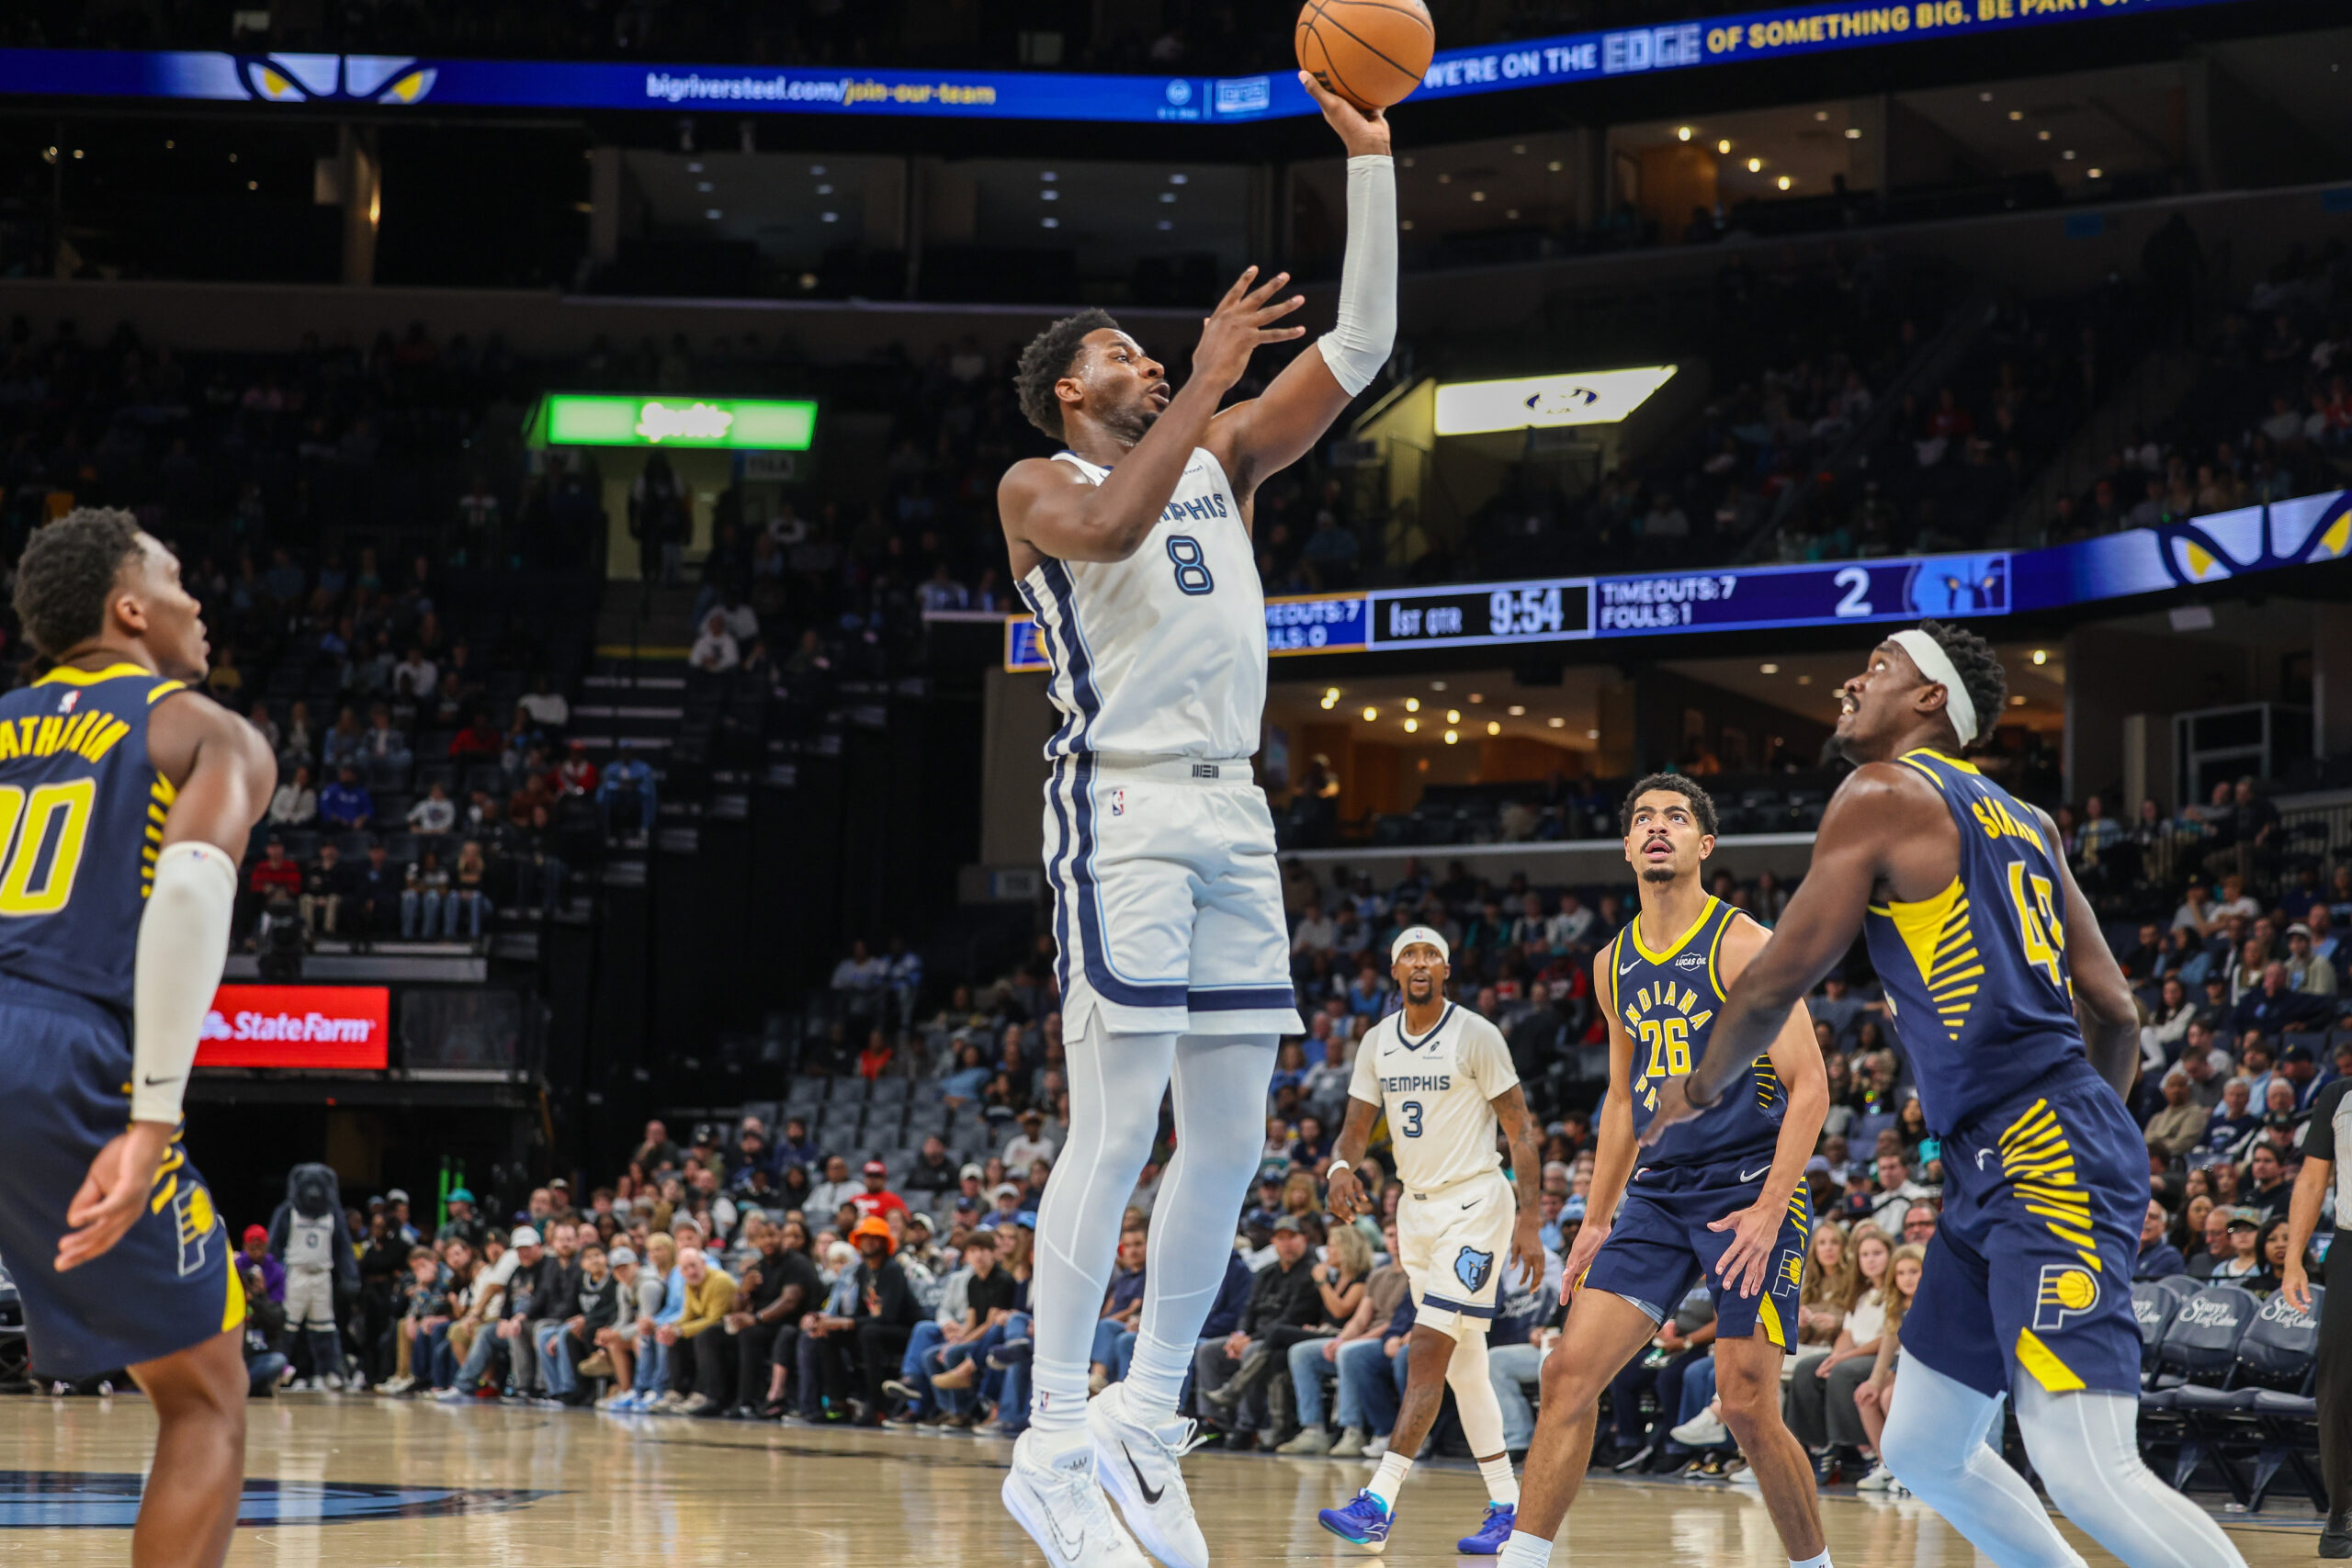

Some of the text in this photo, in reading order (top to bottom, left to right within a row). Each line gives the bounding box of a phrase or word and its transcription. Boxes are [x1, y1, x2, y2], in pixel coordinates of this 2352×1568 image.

[1424, 55, 1498, 88] WE'RE
[1501, 51, 1541, 78] ON
[1544, 43, 1597, 73] THE
[1602, 23, 1701, 73] EDGE
[1706, 26, 1743, 53] OF
[1747, 6, 1910, 49] SOMETHING
[1916, 1, 1971, 28] BIG.
[1977, 0, 2014, 21] BE
[1158, 493, 1227, 523] PHIS
[1166, 535, 1215, 596] 8
[1489, 587, 1565, 635] 9:54
[1834, 566, 1873, 617] 2
[1675, 956, 1706, 966] LUCAS OIL
[1624, 981, 1713, 1039] INDIANA
[1638, 1018, 1691, 1077] 26
[1380, 1076, 1451, 1093] MEMPHIS
[1402, 1101, 1423, 1138] 3
